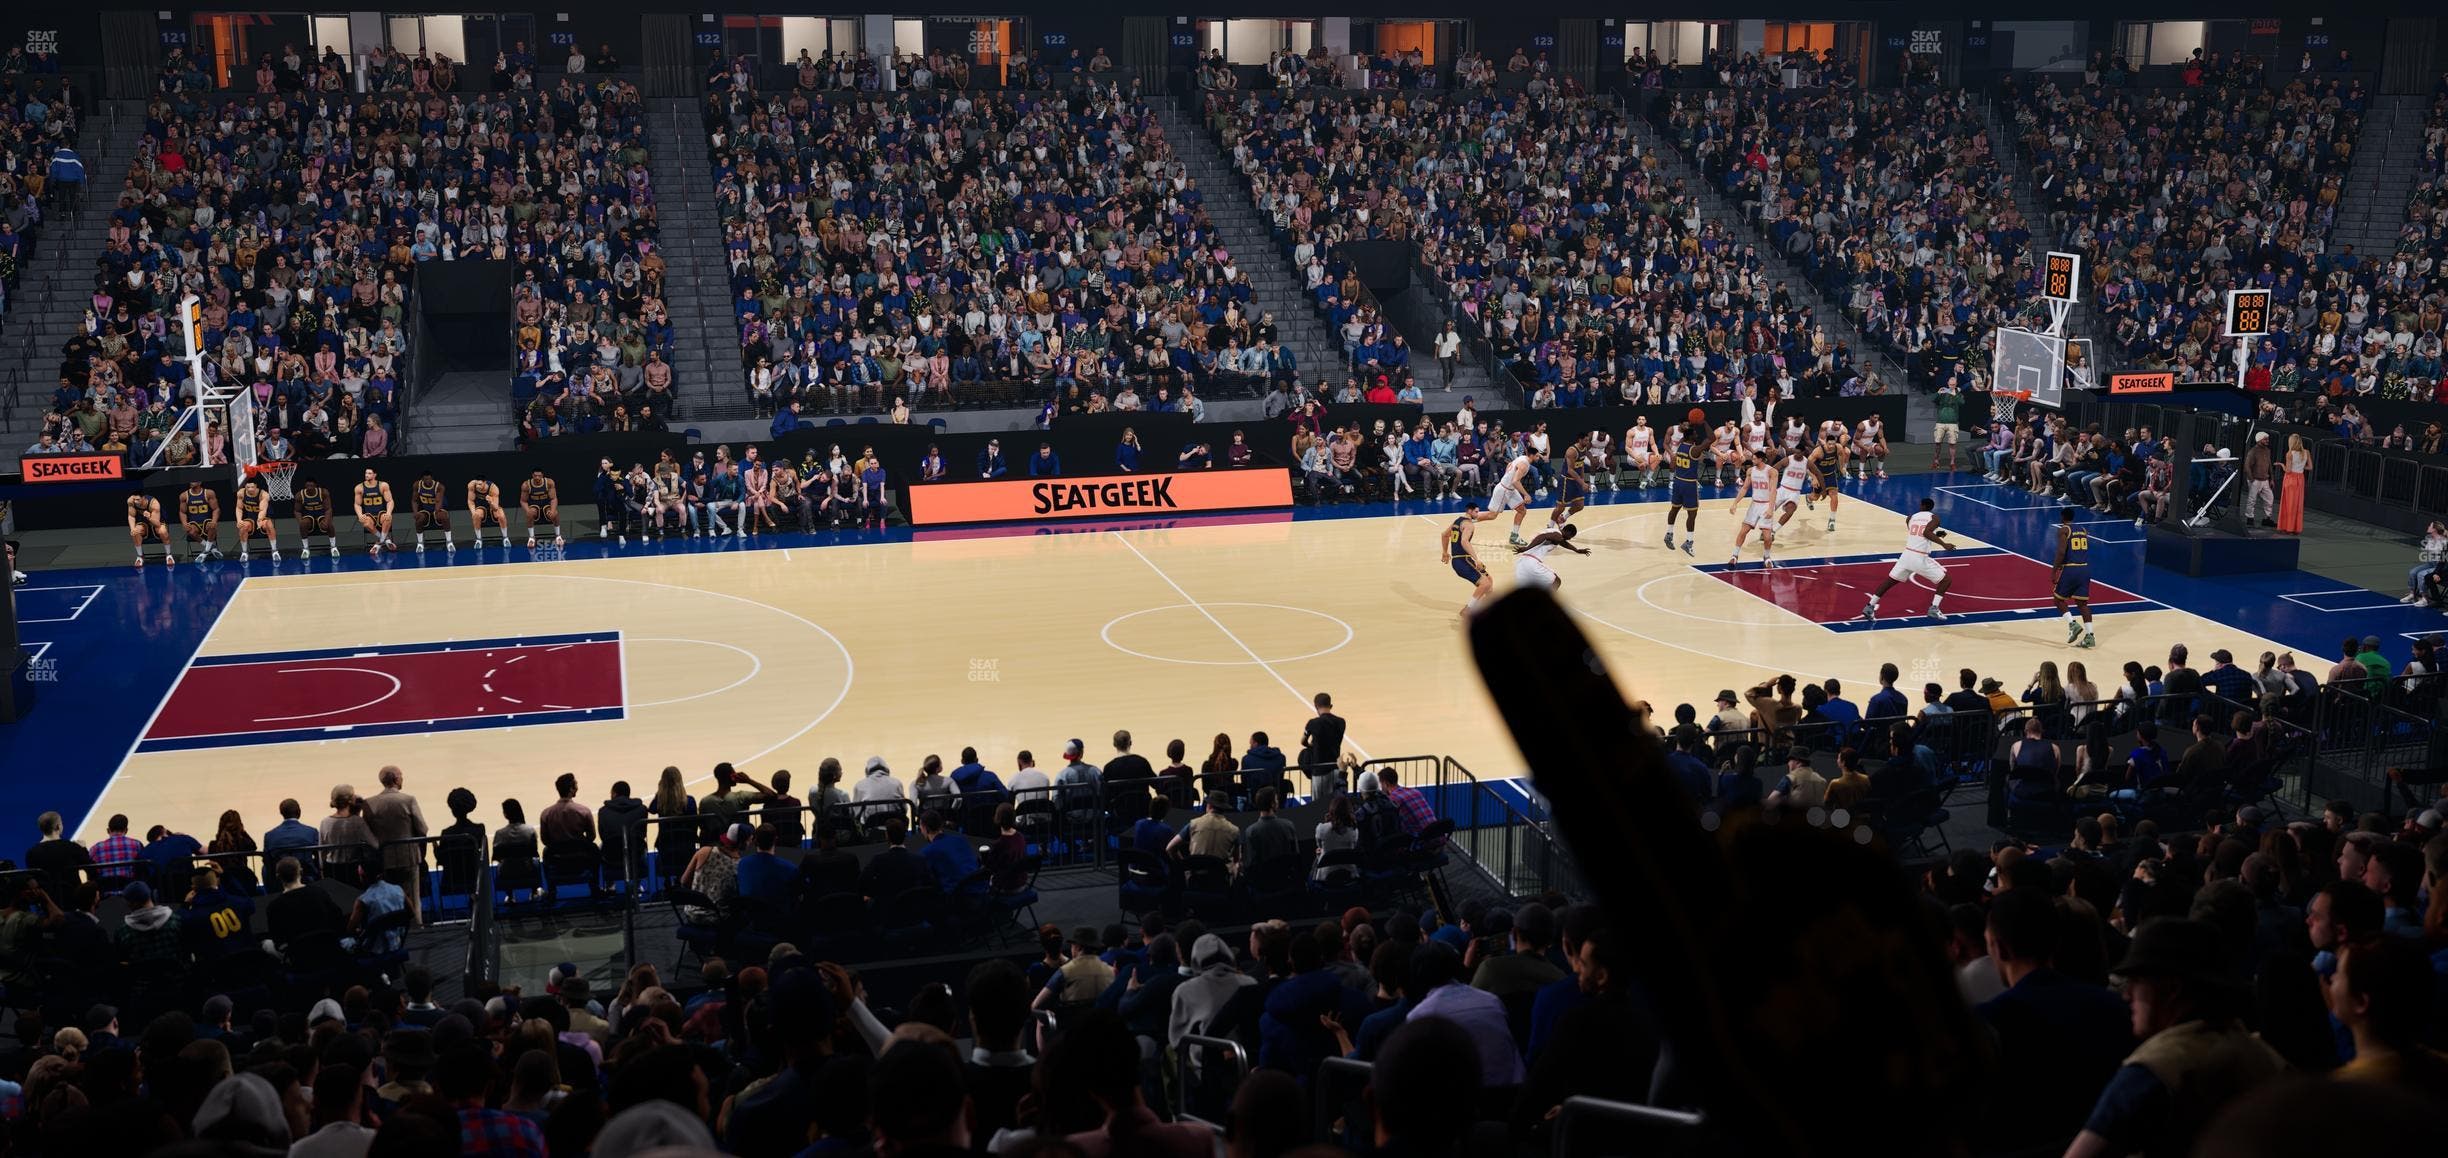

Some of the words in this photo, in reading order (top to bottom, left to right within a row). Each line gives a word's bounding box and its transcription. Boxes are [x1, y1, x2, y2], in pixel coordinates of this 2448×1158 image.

[161, 32, 186, 43] 121
[551, 33, 574, 44] 121
[697, 34, 720, 44] 122
[1043, 35, 1066, 45] 122
[1172, 35, 1193, 45] 123
[1534, 36, 1553, 46] 123
[1968, 37, 1985, 46] 126
[2306, 35, 2329, 45] 126
[2239, 310, 2261, 331] 88
[2118, 376, 2166, 391] SEATGEEK
[31, 459, 113, 478] SEATGEEK
[1033, 476, 1177, 514] SEATGEEK
[209, 907, 242, 939] 00
